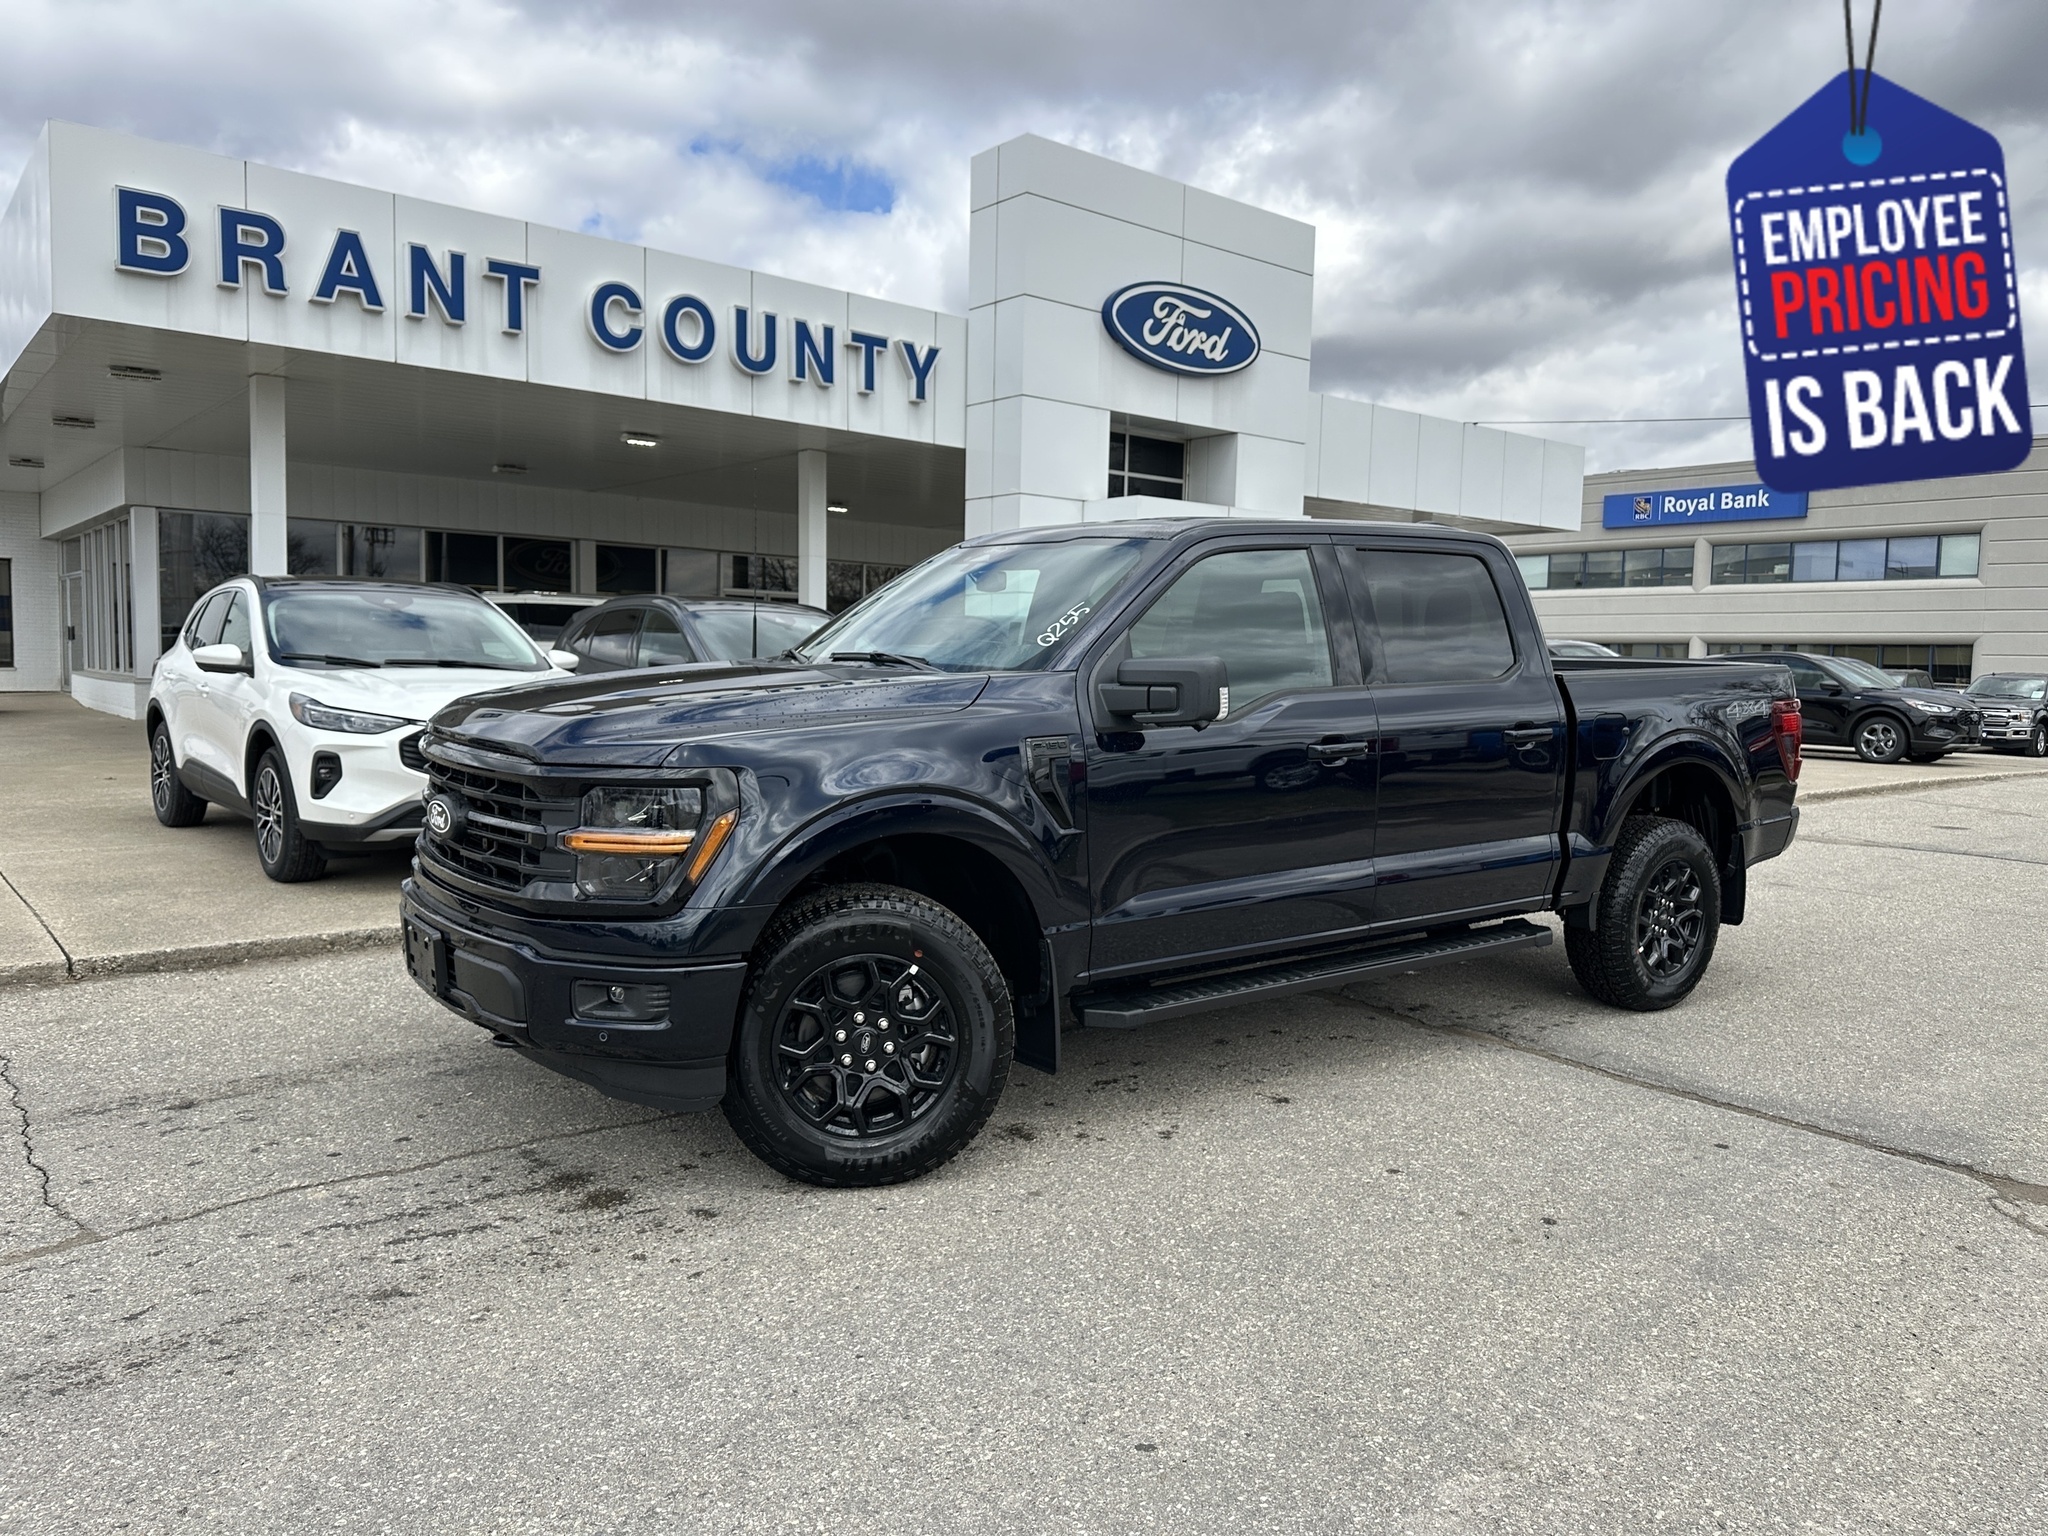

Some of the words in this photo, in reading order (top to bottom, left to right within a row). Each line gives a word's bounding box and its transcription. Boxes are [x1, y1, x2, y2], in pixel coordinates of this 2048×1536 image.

[113, 184, 542, 335] BRANT
[586, 280, 941, 404] COUNTY
[1143, 295, 1233, 362] Ford
[1634, 513, 1650, 521] RBC
[1664, 492, 1716, 517] Royal
[1720, 488, 1770, 510] Bank
[1036, 601, 1091, 647] Q255
